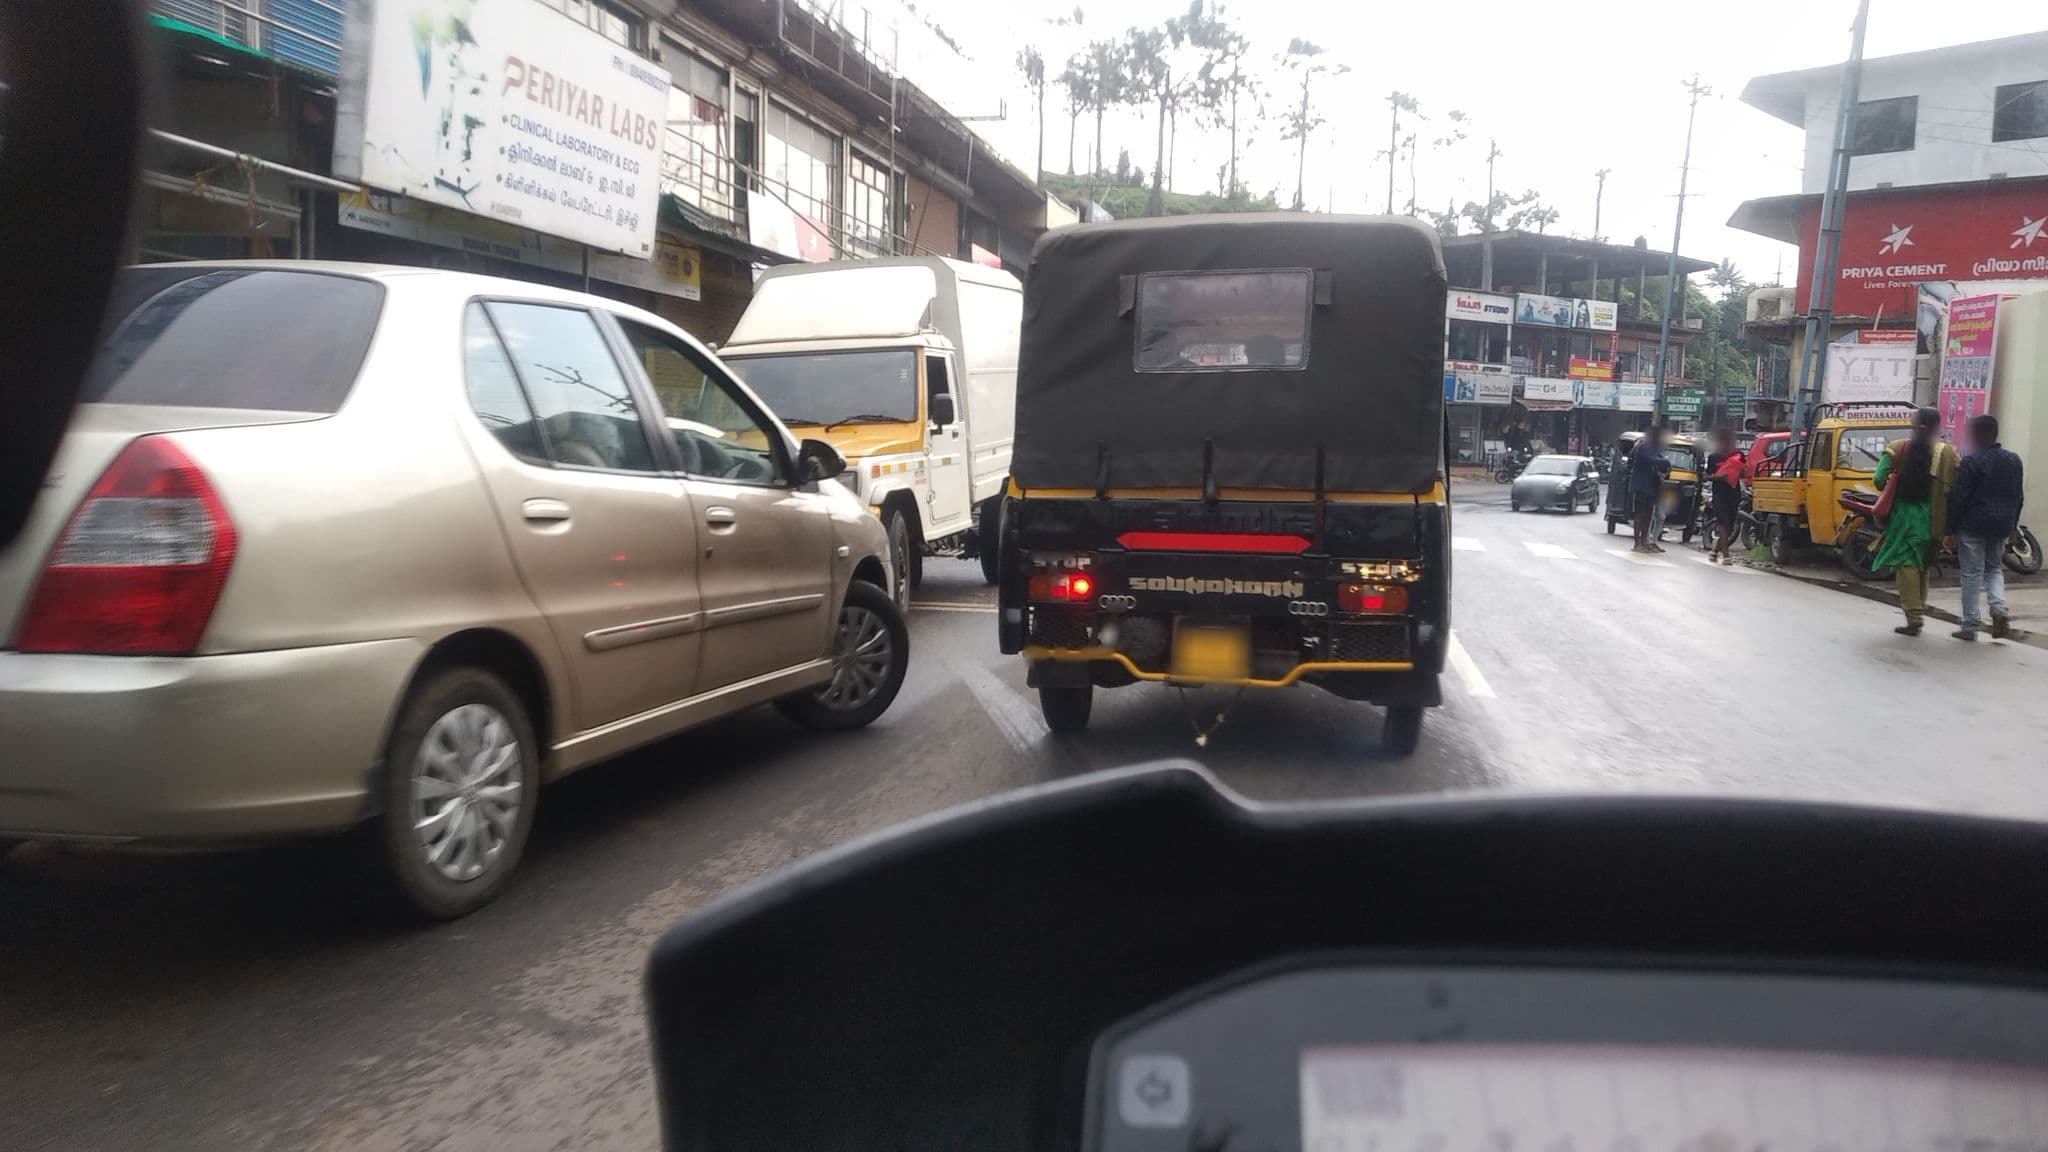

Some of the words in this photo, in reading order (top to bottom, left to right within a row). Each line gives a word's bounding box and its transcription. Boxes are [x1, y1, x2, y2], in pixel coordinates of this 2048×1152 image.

[501, 55, 604, 129] PERIYAR
[610, 103, 657, 151] LABS
[510, 113, 553, 143] CLINICAL
[556, 134, 614, 166] LABORATORY
[615, 157, 621, 168] &
[622, 158, 639, 176] ECG
[1842, 267, 1883, 279] PRIYA
[1886, 263, 1946, 277] CEMENT
[1864, 281, 1885, 289] Lives
[1483, 304, 1509, 315] STUDIO
